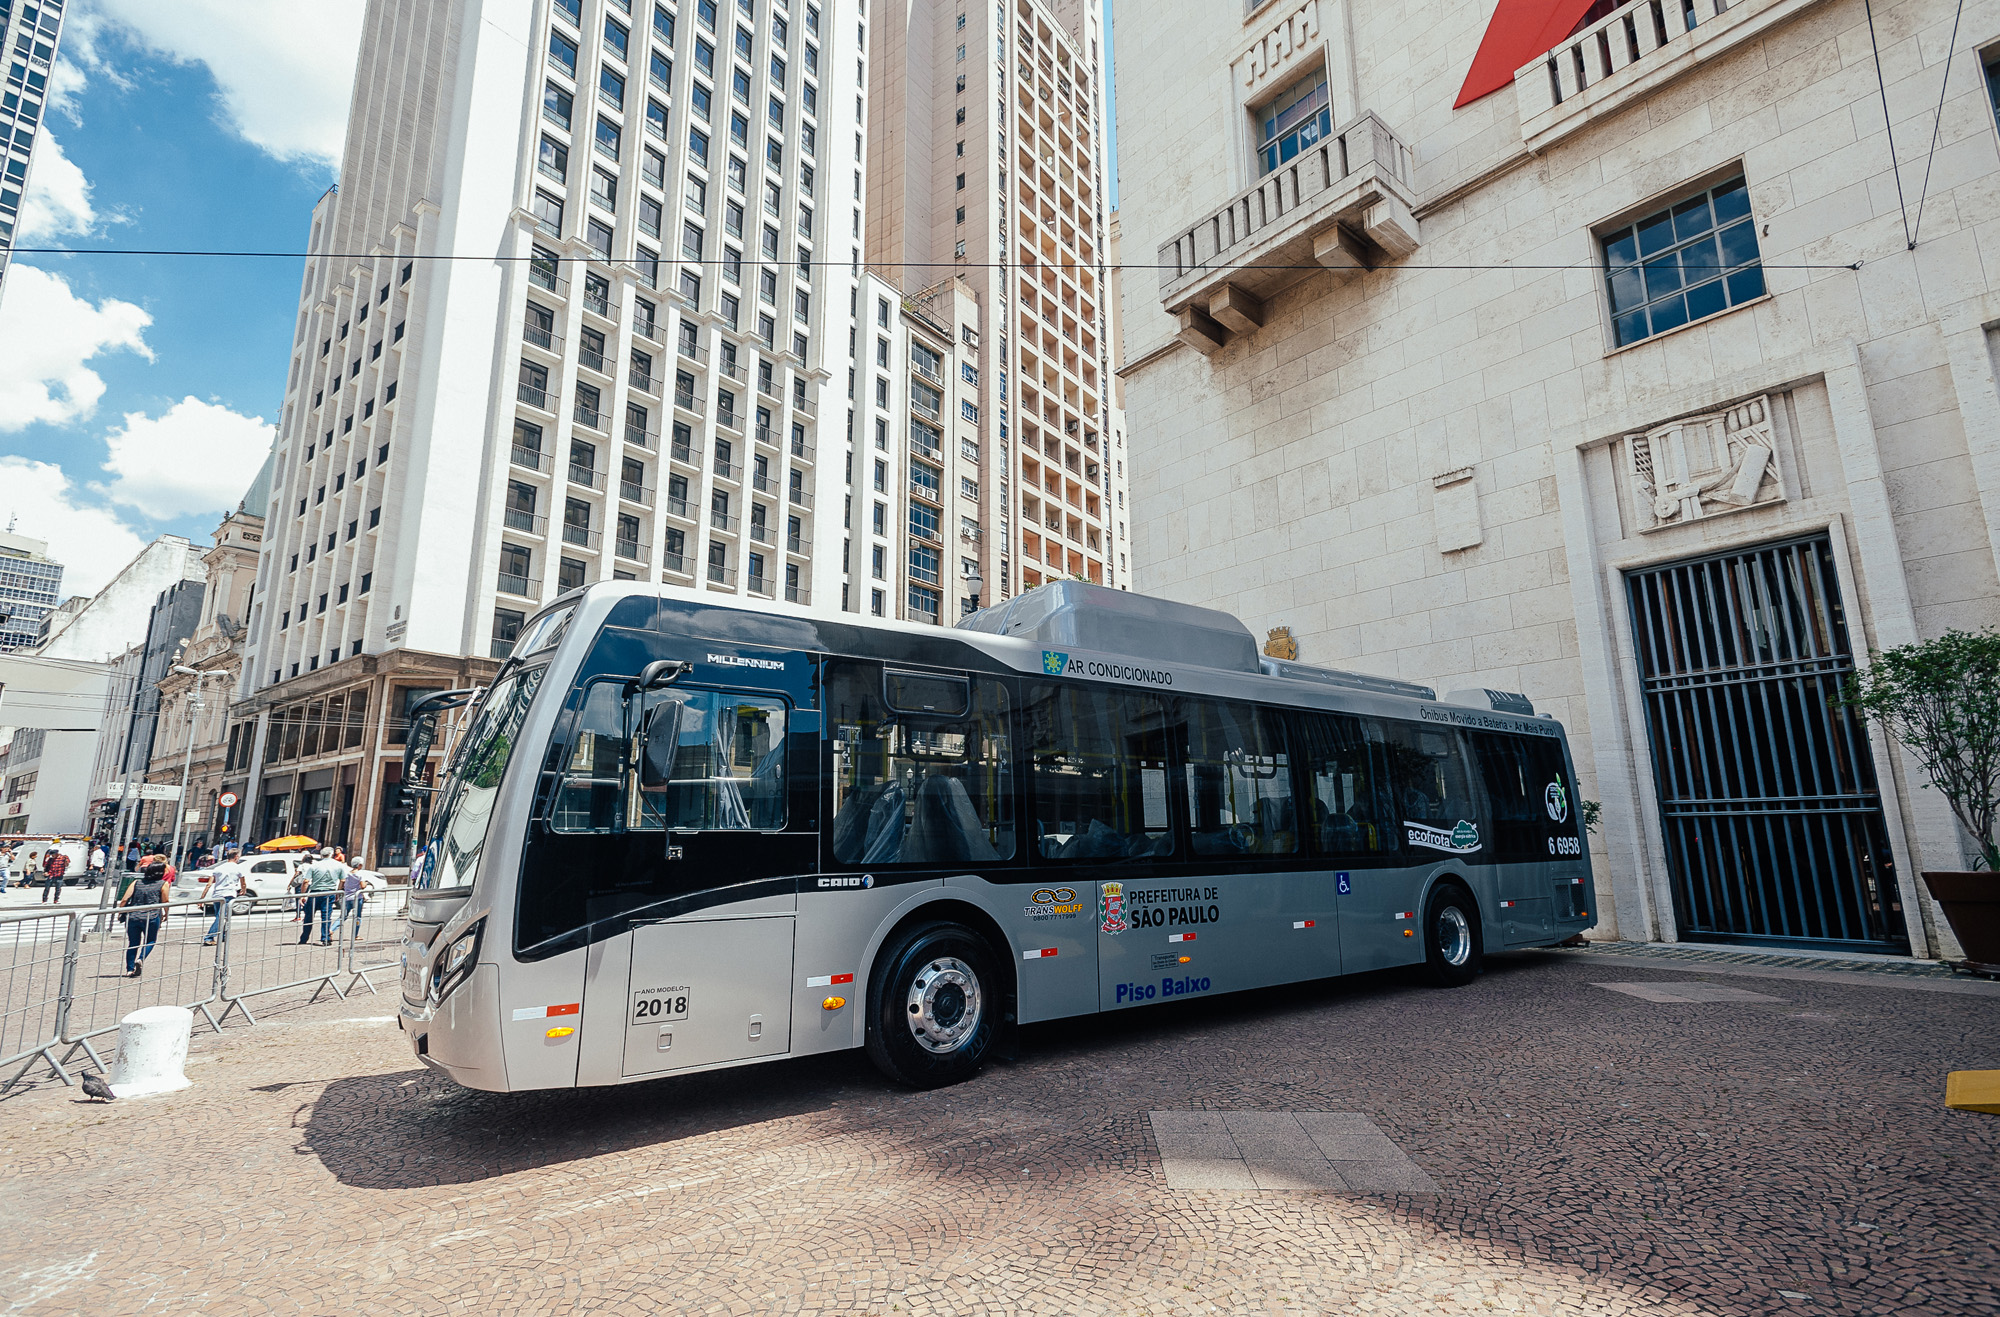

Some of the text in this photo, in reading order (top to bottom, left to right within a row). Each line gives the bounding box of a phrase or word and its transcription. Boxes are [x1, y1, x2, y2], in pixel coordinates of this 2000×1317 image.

[707, 653, 785, 671] MILLENNIUM
[1068, 659, 1173, 685] AR CONDICIONADO
[1420, 705, 1449, 722] Ônibus
[1449, 712, 1476, 726] Movido
[1483, 716, 1509, 730] Bateria
[1514, 722, 1524, 732] Ar
[1524, 723, 1539, 734] Mais
[1540, 725, 1554, 736] Puro
[1408, 829, 1451, 847] ecofrota
[1548, 836, 1580, 855] 6 6958
[818, 878, 861, 887] CAIO
[1129, 887, 1218, 904] PREFEITURA DE
[1131, 905, 1219, 929] SÃO PAULO
[657, 985, 685, 993] MODELO
[1116, 976, 1211, 1004] Piso Baixo
[635, 996, 687, 1017] 2018
